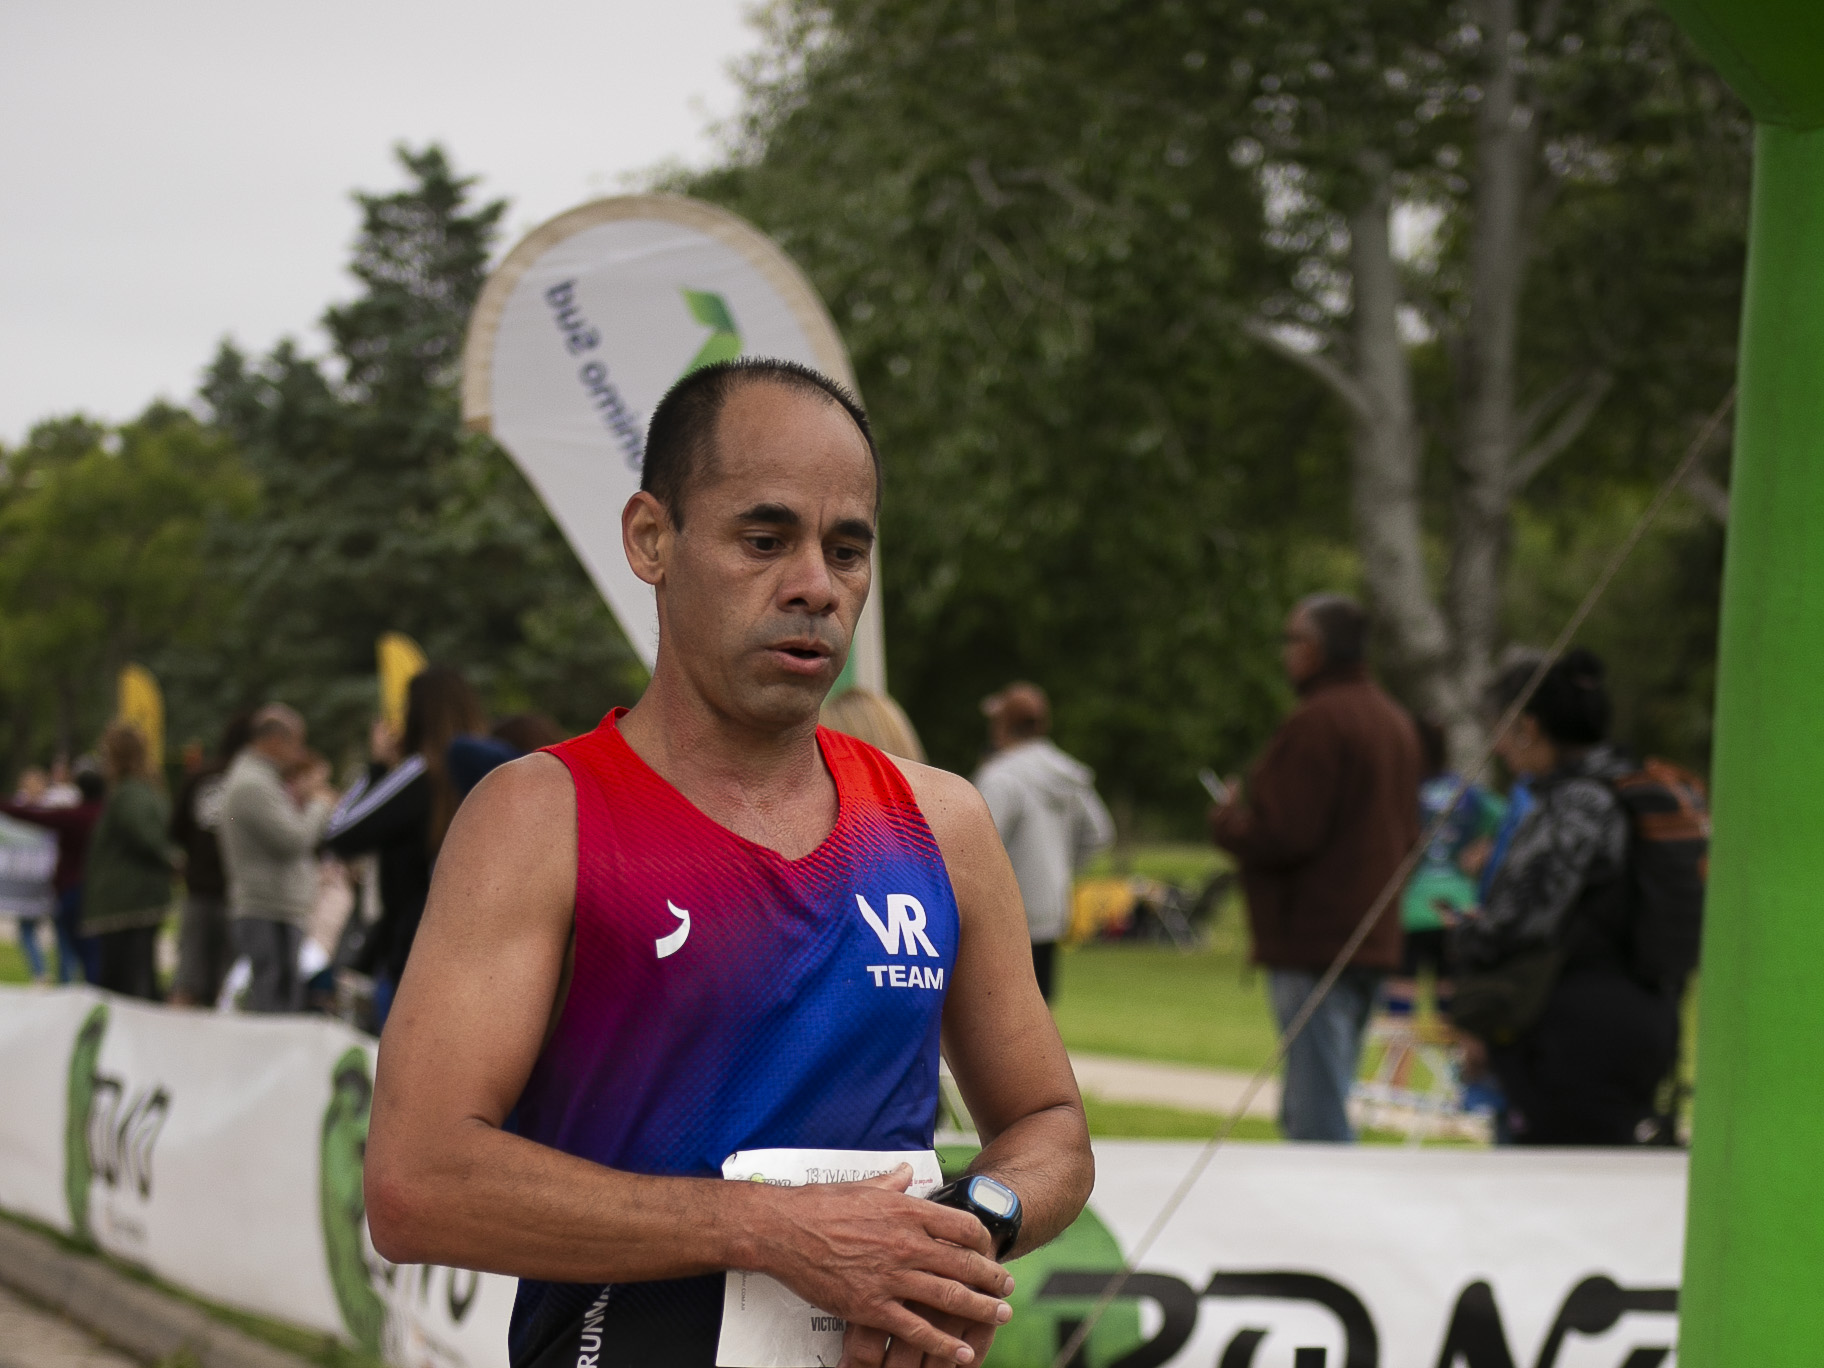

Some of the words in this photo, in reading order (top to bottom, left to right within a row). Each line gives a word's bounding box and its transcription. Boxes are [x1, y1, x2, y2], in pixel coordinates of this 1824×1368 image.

[855, 893, 940, 957] VR
[866, 965, 944, 990] TEAM
[811, 1316, 844, 1332] VICTOR
